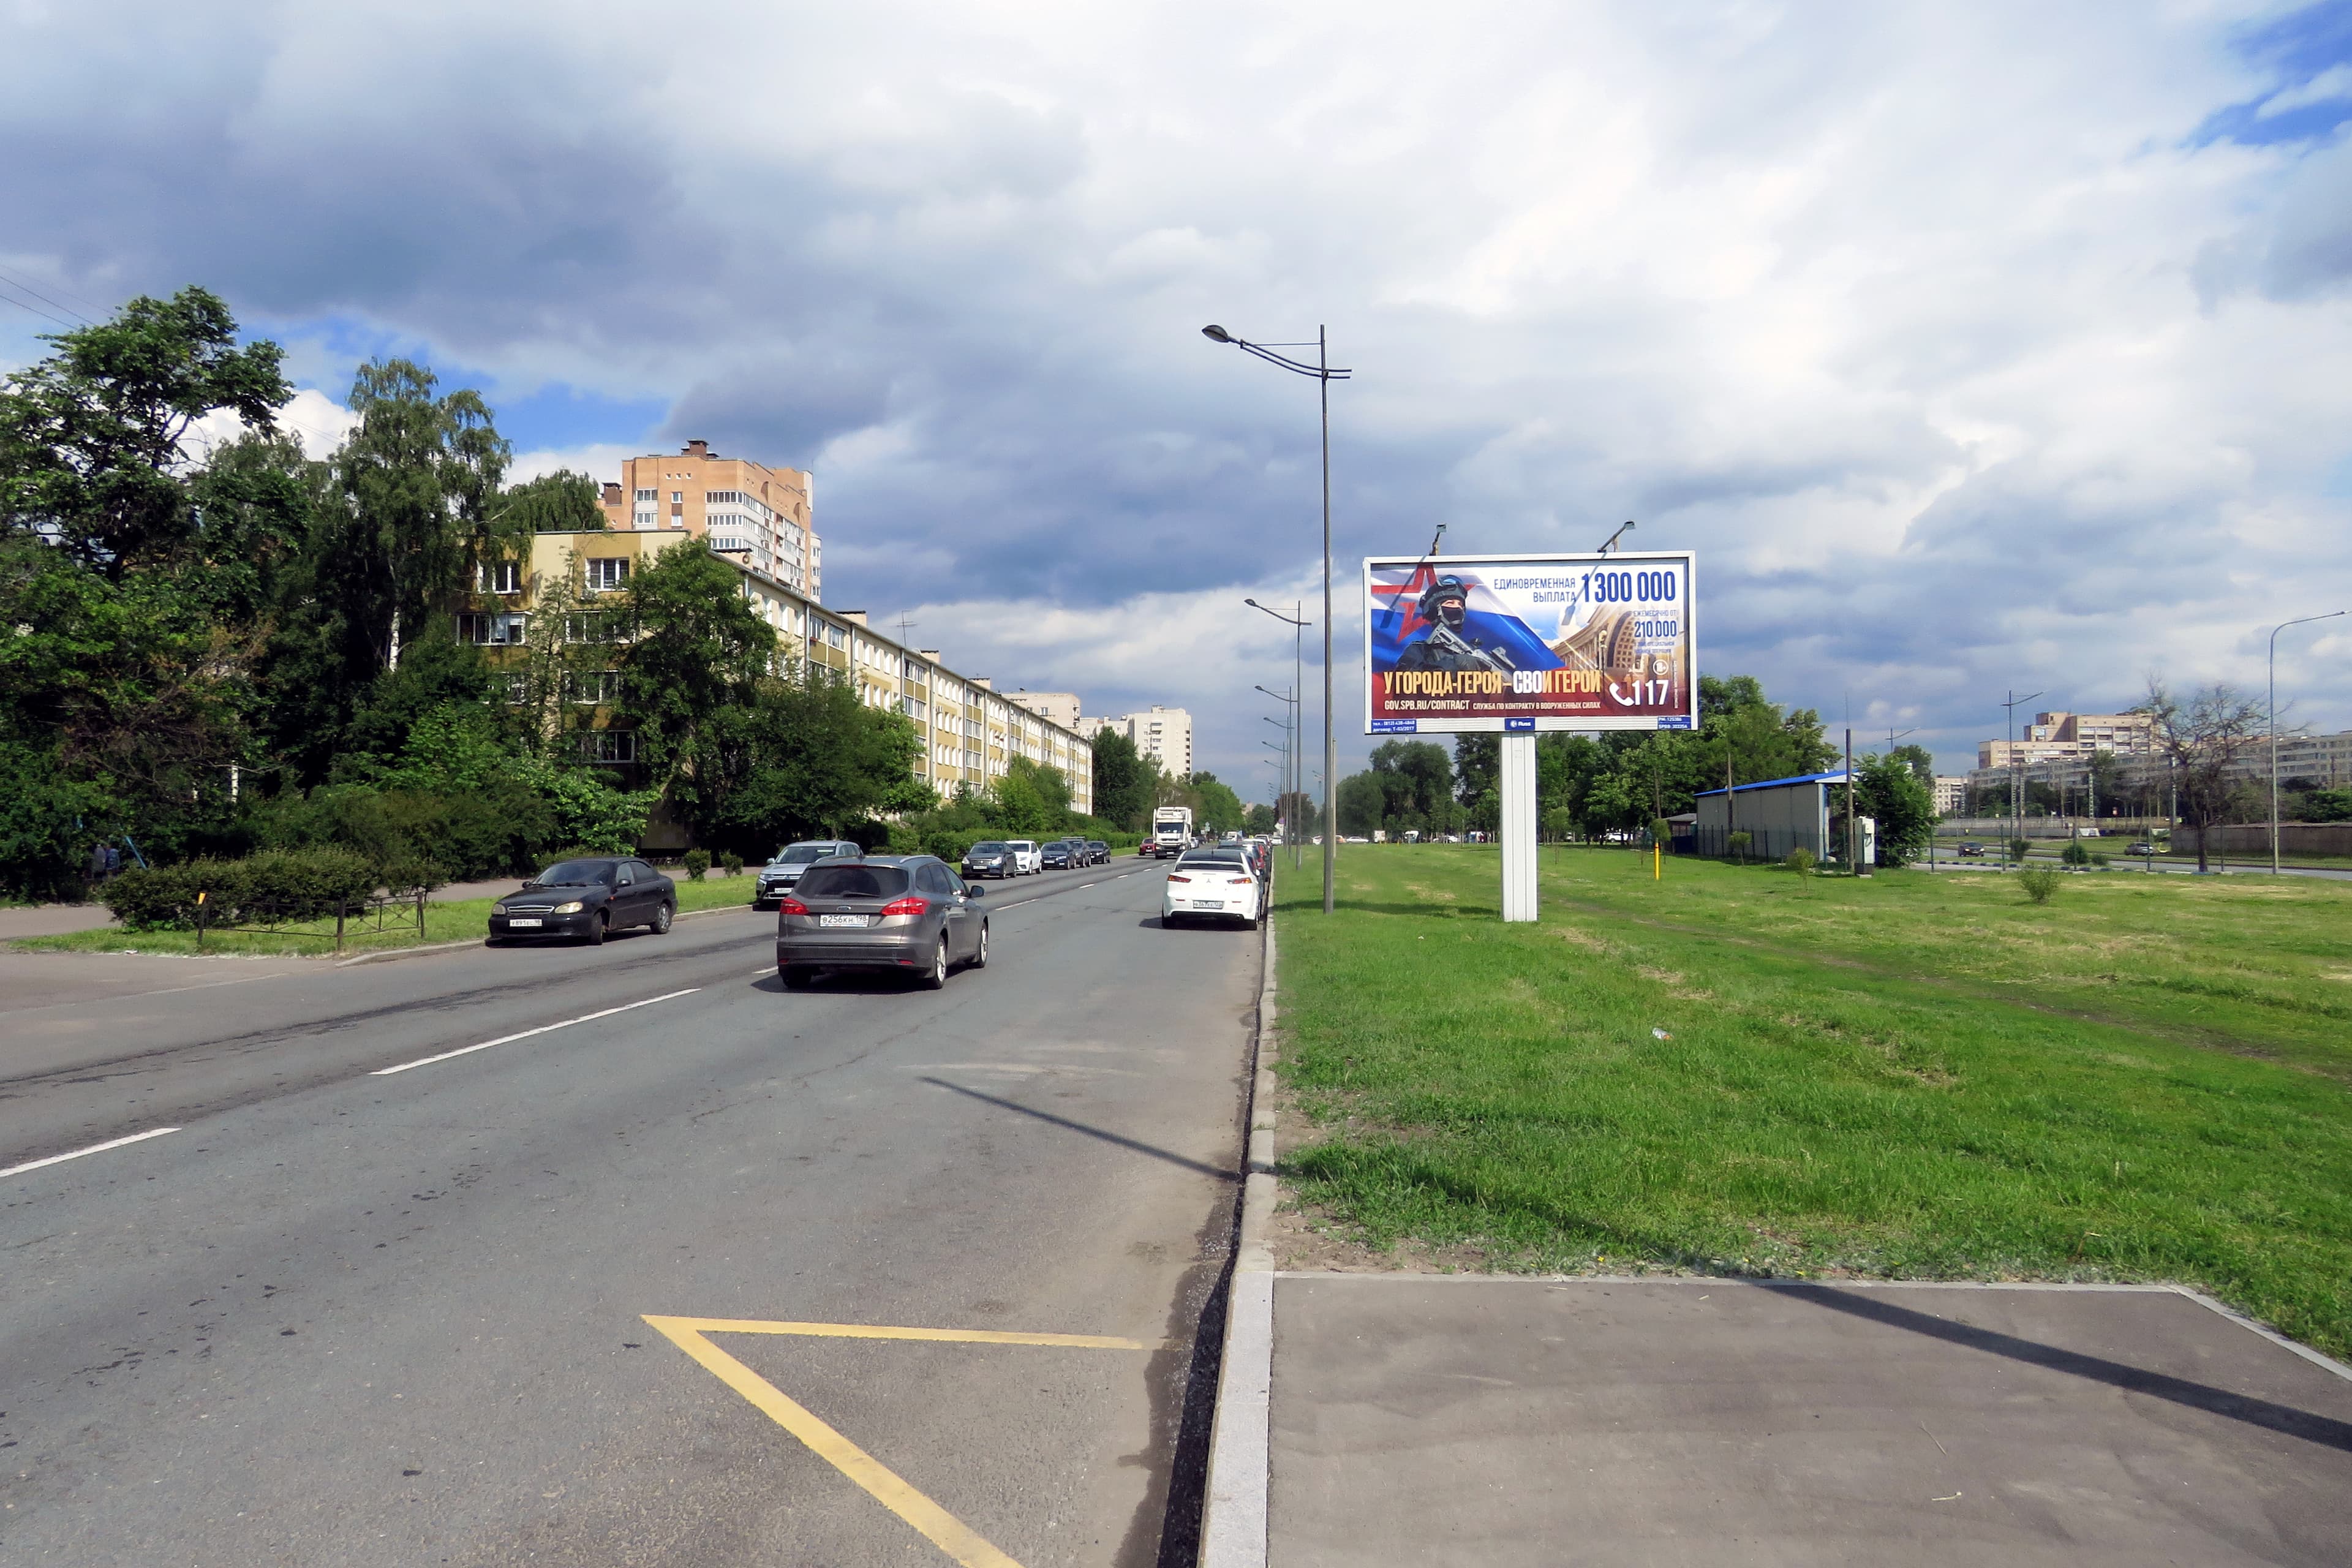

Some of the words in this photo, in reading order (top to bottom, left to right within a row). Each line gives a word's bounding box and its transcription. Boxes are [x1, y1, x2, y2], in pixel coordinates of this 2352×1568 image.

[1494, 578, 1576, 590] ЕДИНОВРЕМЕННАЯ
[1594, 572, 1632, 603] 300
[1637, 571, 1676, 602] 000
[1533, 591, 1577, 603] ВЫПЛАТА
[1634, 620, 1653, 638] 210
[1656, 620, 1677, 637] 000
[1384, 671, 1393, 695] У
[1395, 671, 1502, 697] ГОРОДА-ГЕРОЯ
[1513, 670, 1553, 694] СВОИ
[1632, 679, 1669, 706] 117
[1384, 700, 1471, 710] GOV.SPB.RU/CONTRACT
